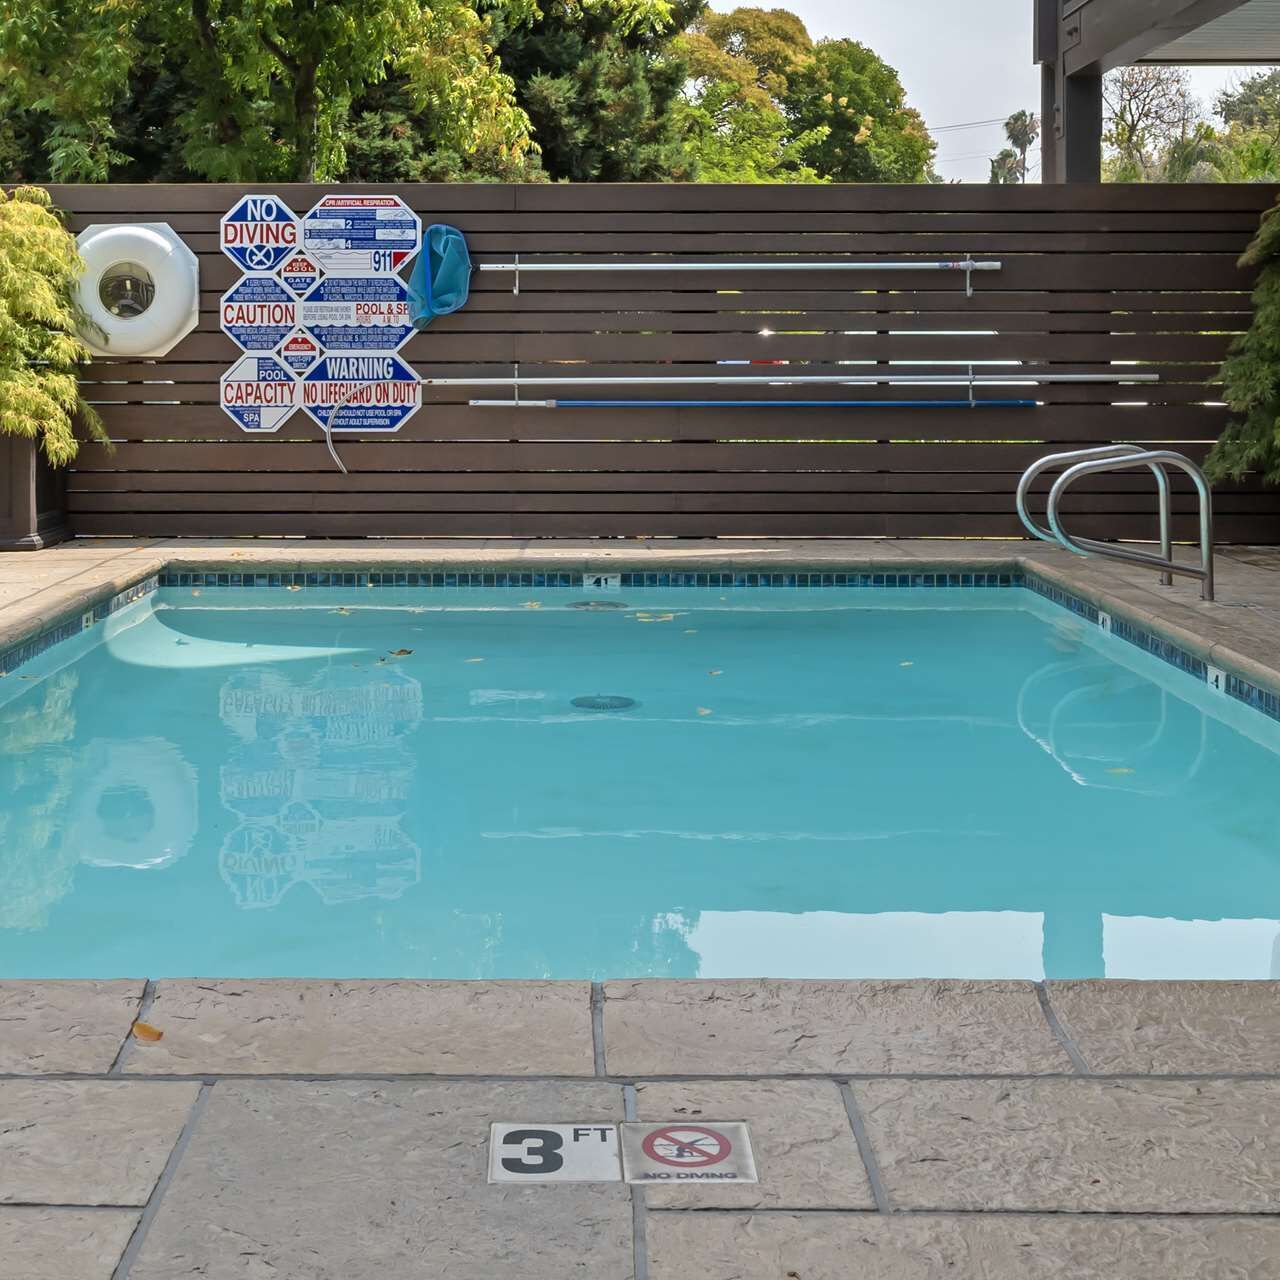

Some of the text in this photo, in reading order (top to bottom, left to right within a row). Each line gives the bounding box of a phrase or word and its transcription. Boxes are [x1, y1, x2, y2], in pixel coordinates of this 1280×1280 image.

[247, 199, 277, 221] NO
[315, 209, 320, 218] 1
[345, 220, 352, 229] 2
[224, 223, 296, 244] DIVING
[304, 230, 310, 238] 3
[345, 240, 352, 249] 4
[373, 251, 392, 272] 911
[224, 304, 295, 324] CAUTION
[356, 303, 384, 315] POOL
[387, 303, 394, 314] &
[259, 370, 287, 380] POOL
[326, 358, 394, 379] WARNING
[224, 383, 296, 404] CAPACITY
[303, 383, 317, 403] NO
[375, 382, 389, 403] ON
[393, 382, 417, 403] DUTY
[243, 413, 260, 422] SPA
[501, 1128, 613, 1174] 3 FT
[642, 1172, 738, 1180] NO DIVING
